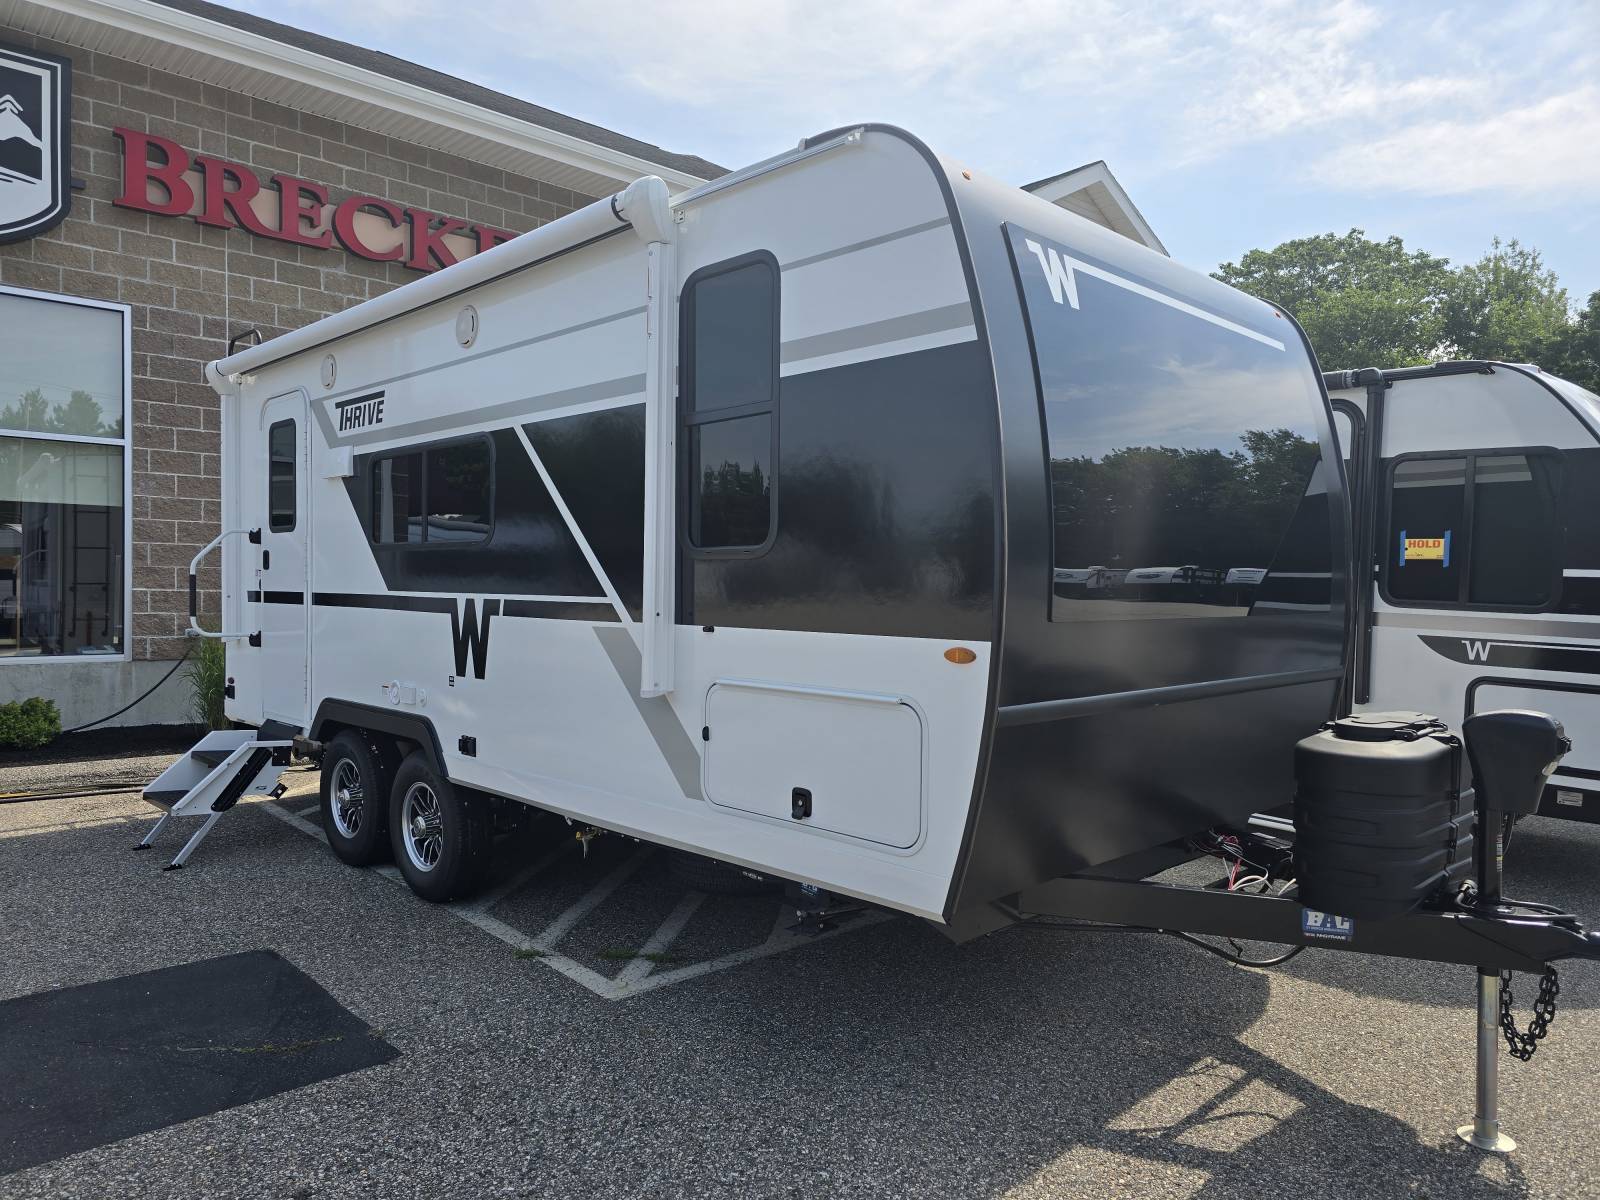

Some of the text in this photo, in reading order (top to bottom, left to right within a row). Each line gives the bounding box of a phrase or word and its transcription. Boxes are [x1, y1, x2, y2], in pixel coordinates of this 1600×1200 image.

[1025, 238, 1081, 311] W
[335, 390, 385, 431] THRIVE
[1408, 540, 1441, 549] HOLD
[450, 597, 501, 680] W
[1461, 640, 1491, 661] W
